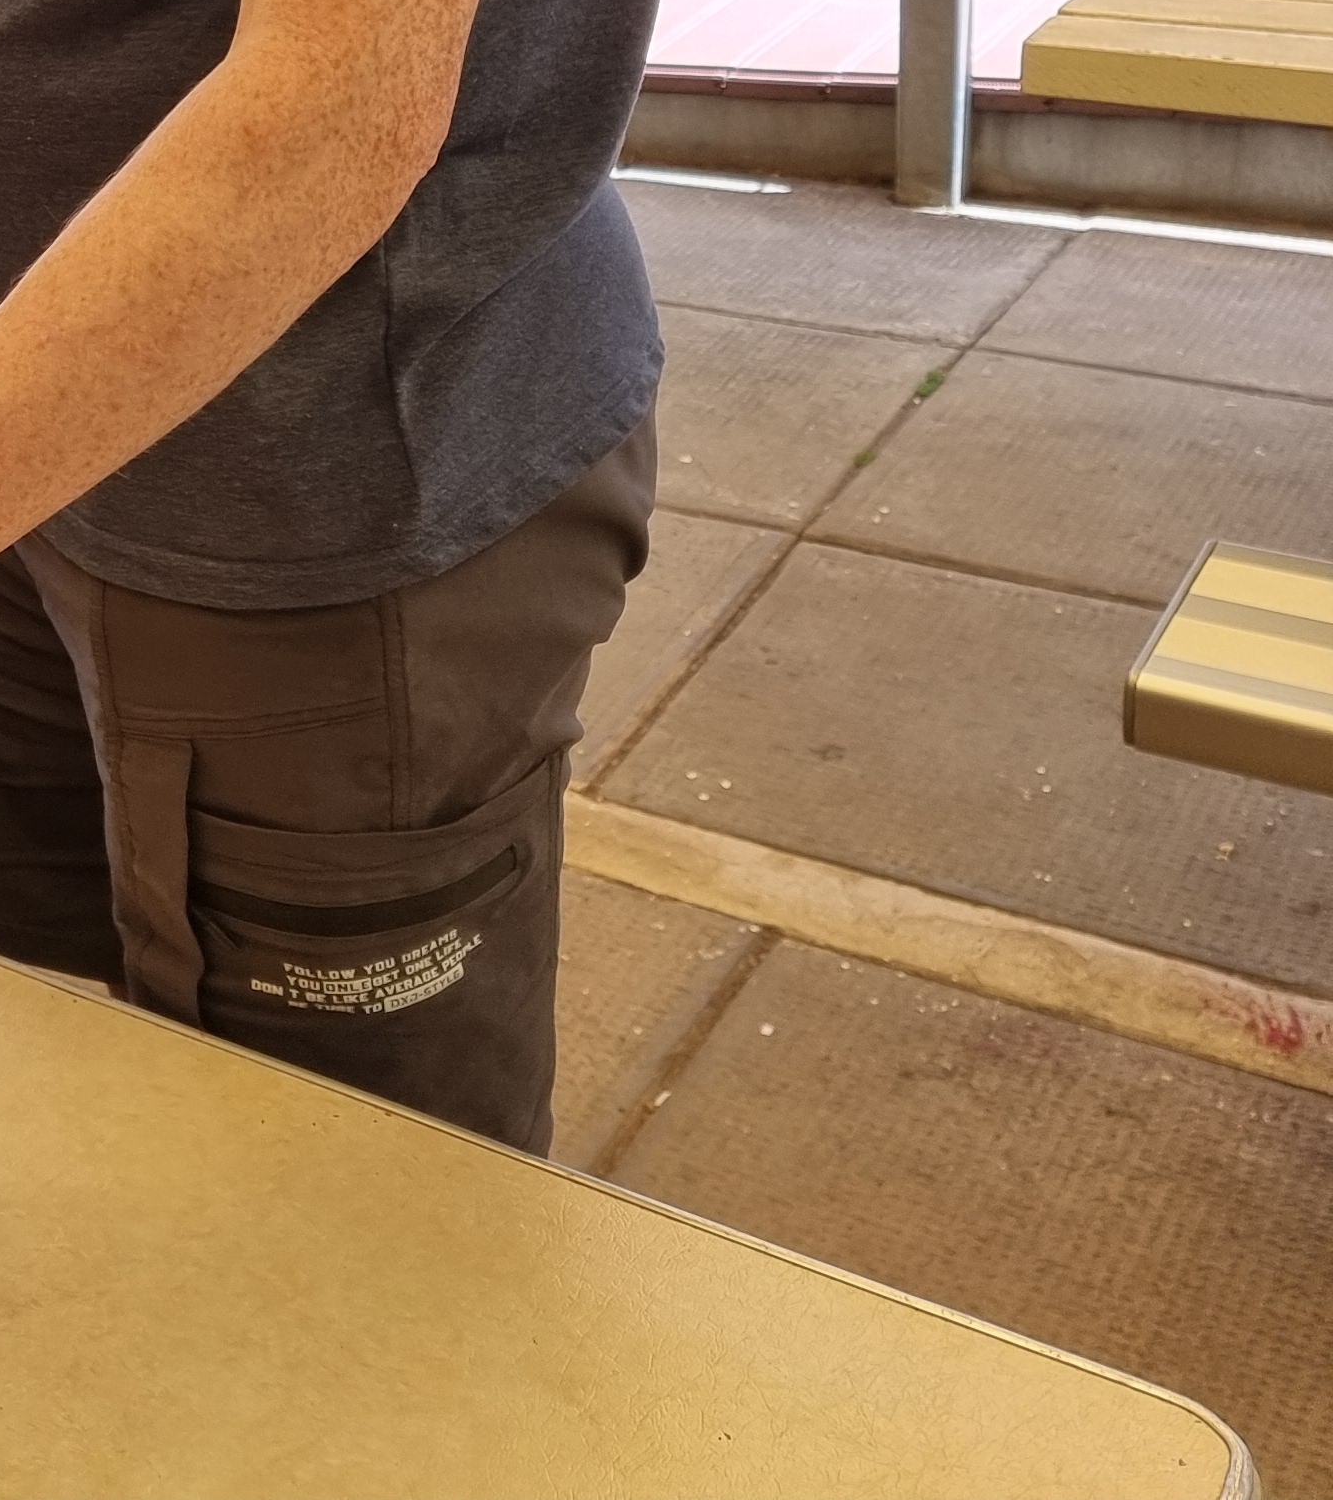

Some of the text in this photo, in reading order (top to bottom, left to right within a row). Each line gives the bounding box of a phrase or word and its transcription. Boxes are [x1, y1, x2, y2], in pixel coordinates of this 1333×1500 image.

[283, 962, 356, 980] FOLLOW
[363, 956, 396, 975] YOU
[286, 975, 321, 991] YOU
[371, 971, 401, 988] GET
[405, 957, 434, 975] ONE
[435, 938, 463, 961] LIFE
[305, 991, 328, 1004] BE
[332, 990, 370, 1004] LIKE
[375, 969, 438, 1000] AVERAGE
[363, 1002, 383, 1015] TO
